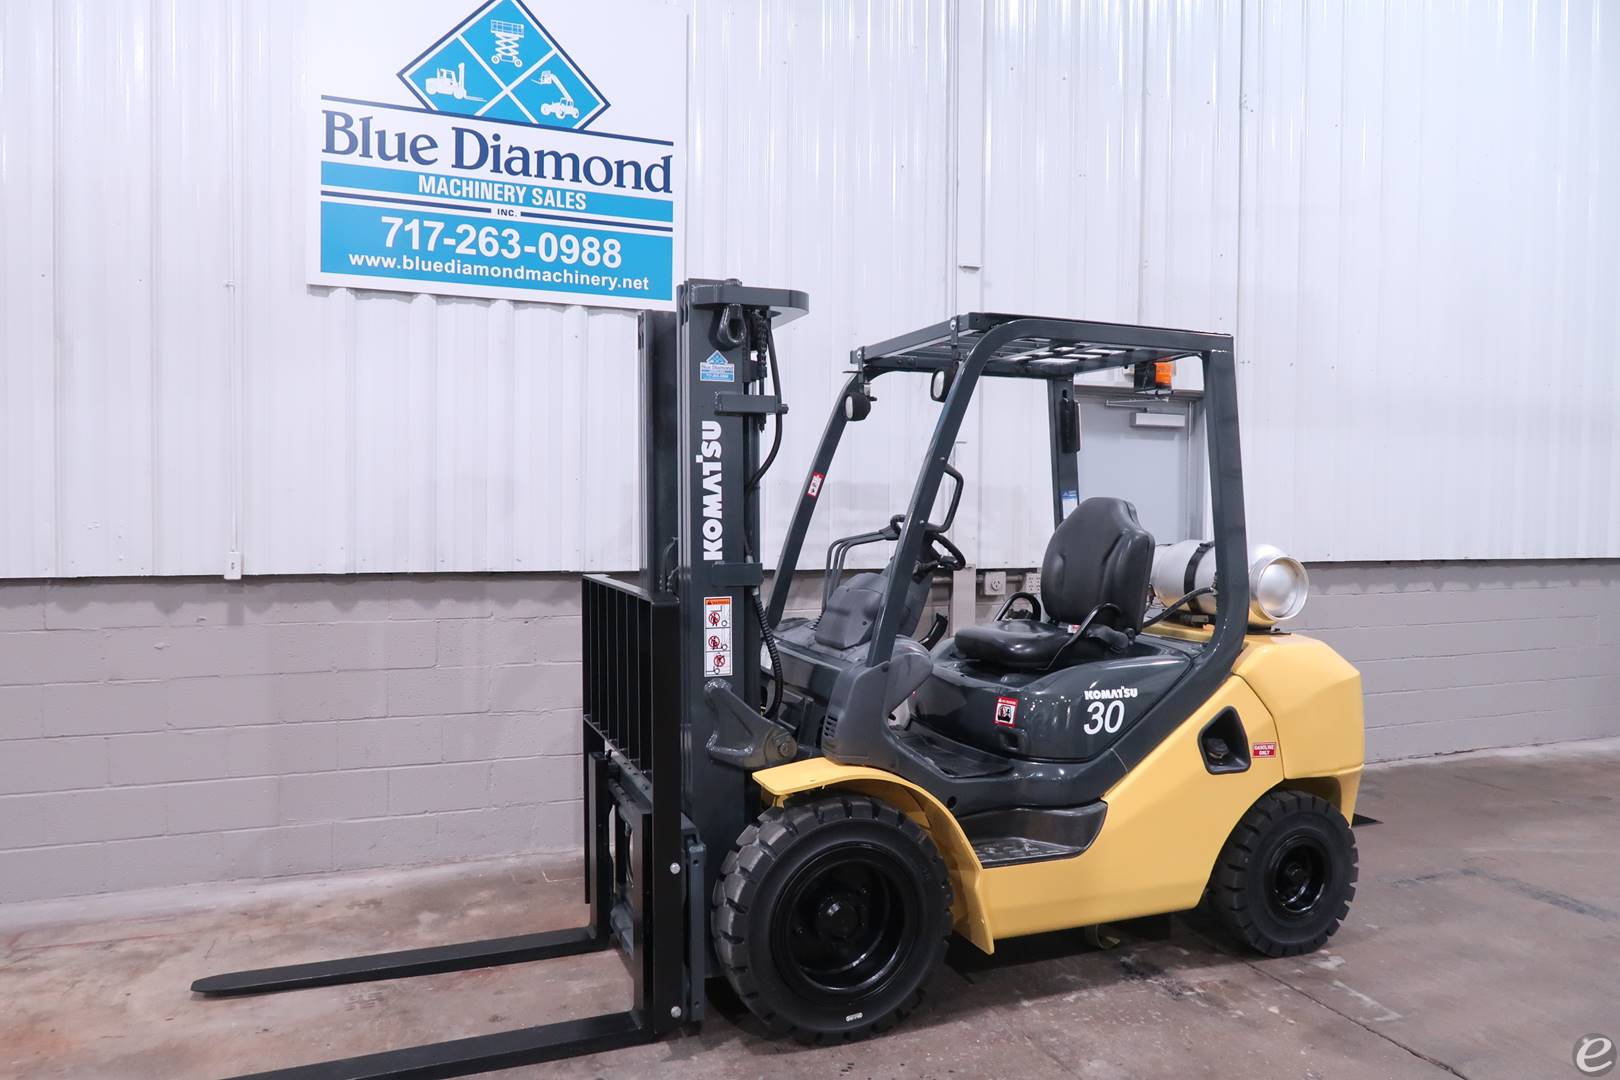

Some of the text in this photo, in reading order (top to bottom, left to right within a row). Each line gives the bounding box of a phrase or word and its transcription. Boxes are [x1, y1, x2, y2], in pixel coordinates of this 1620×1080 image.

[321, 109, 674, 194] Blue Diamond
[418, 174, 587, 210] MACHINERY SALES
[497, 208, 517, 217] INC.
[381, 216, 622, 269] 717-263-0988
[349, 253, 649, 291] www.bluediamondmachinery.net
[696, 420, 723, 561] KOMATSU
[1084, 686, 1138, 700] KOMATSU
[1084, 700, 1125, 735] 30
